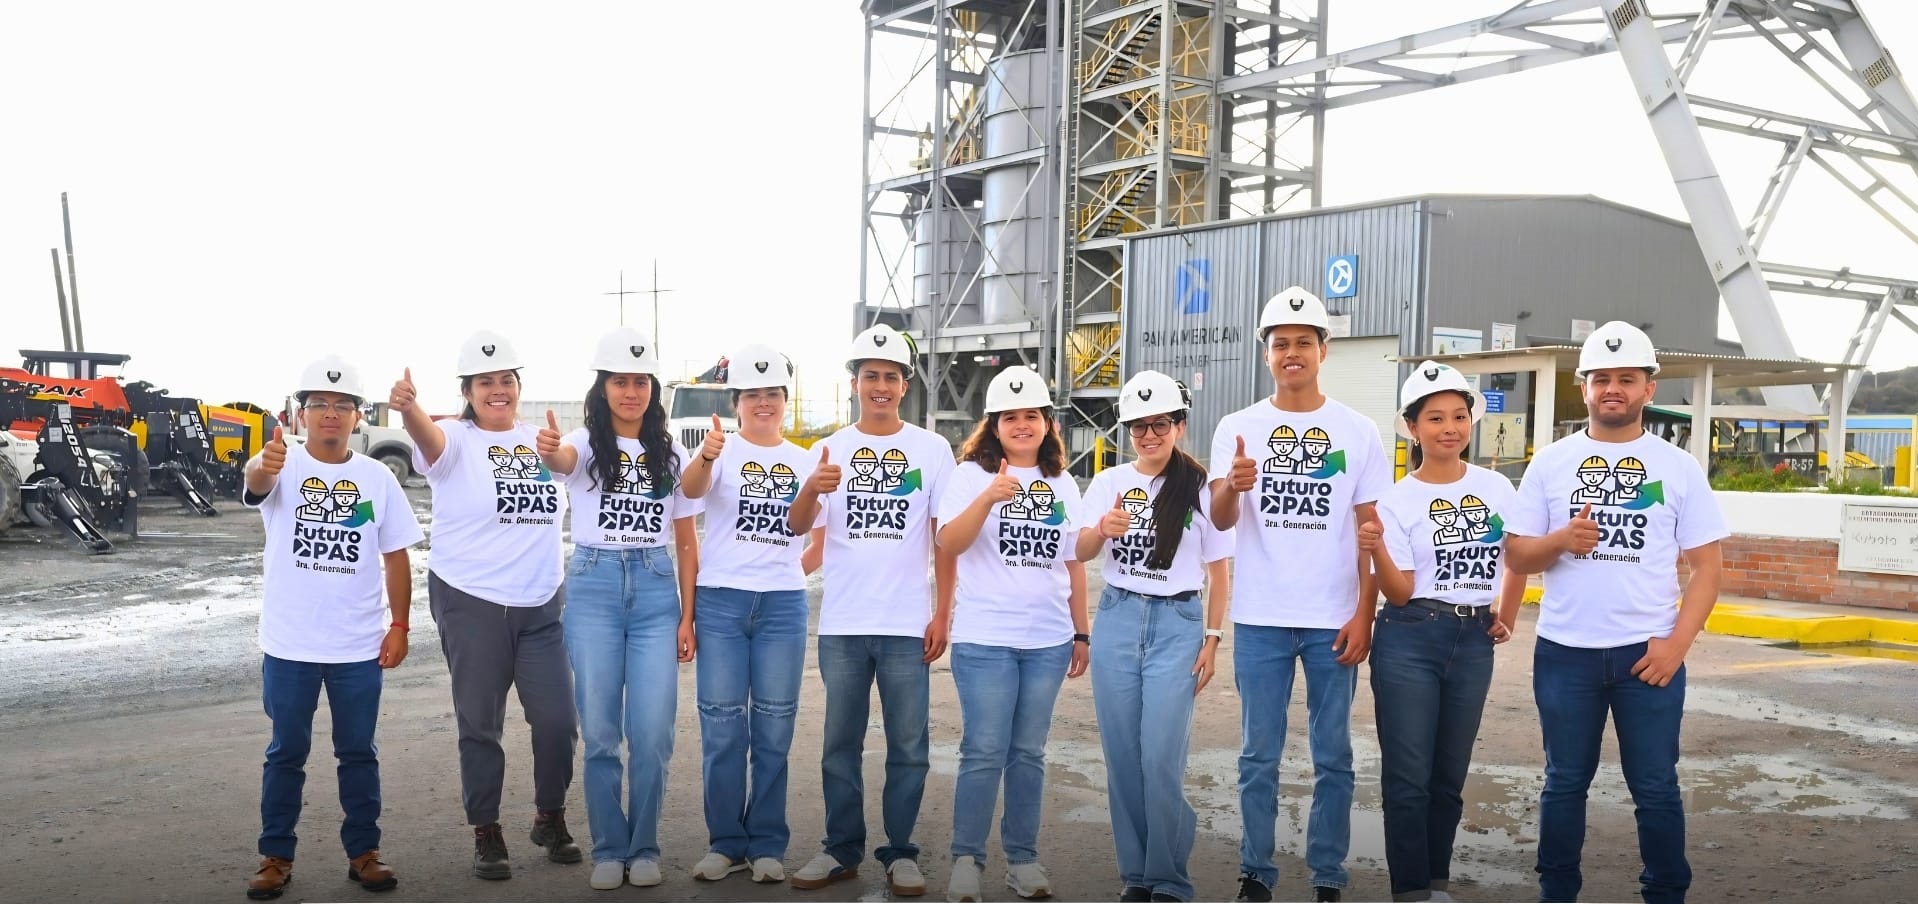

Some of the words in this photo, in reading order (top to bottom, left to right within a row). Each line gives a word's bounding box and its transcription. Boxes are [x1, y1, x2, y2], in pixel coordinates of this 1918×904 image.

[1142, 331, 1166, 348] PAN
[1170, 326, 1242, 346] AMERICAN
[496, 481, 557, 496] Futuro
[1262, 476, 1332, 496] Futuro
[517, 496, 558, 513] PAS
[600, 494, 664, 516] Futuro
[738, 500, 790, 517] Futur
[847, 495, 909, 511] Futuro
[1282, 496, 1330, 516] PAS
[619, 513, 662, 533] PAS
[865, 511, 906, 530] PAS
[1282, 520, 1327, 530] Generación
[295, 520, 362, 544] Futuro
[999, 521, 1061, 542] Futuro
[313, 542, 359, 563] PAS
[1019, 540, 1058, 559] PAS
[1435, 546, 1500, 567] Futuro
[1592, 550, 1640, 563] Generación
[1453, 560, 1497, 580] PAS
